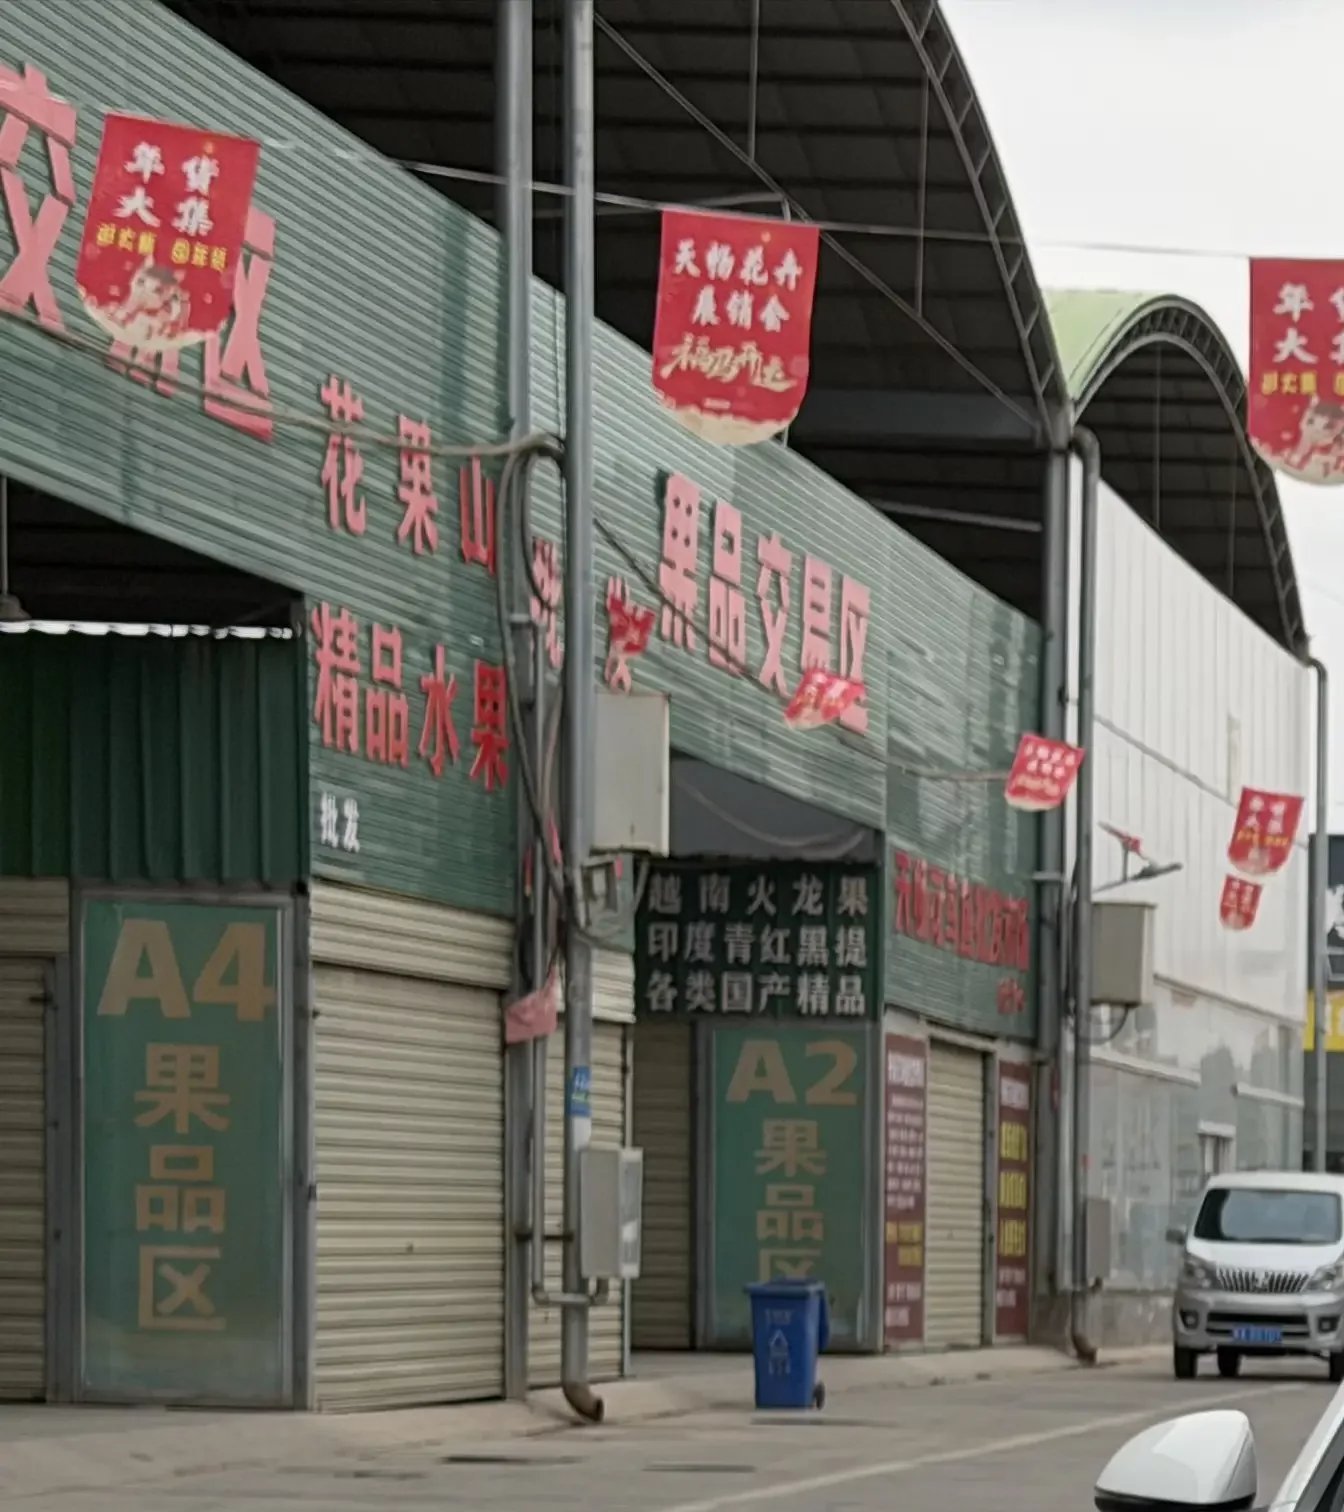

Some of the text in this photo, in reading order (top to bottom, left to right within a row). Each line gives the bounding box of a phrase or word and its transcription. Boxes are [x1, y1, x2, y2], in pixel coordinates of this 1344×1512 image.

[124, 140, 220, 197] 年货
[112, 185, 215, 237] 大集
[309, 600, 511, 794] 精品水果
[648, 872, 869, 918] 越南火龙果
[96, 918, 278, 1022] A4
[648, 920, 868, 969] 印度青红黑提
[645, 968, 867, 1016] 各类国产精品
[724, 1038, 858, 1106] A2
[132, 1042, 233, 1333] 果品区
